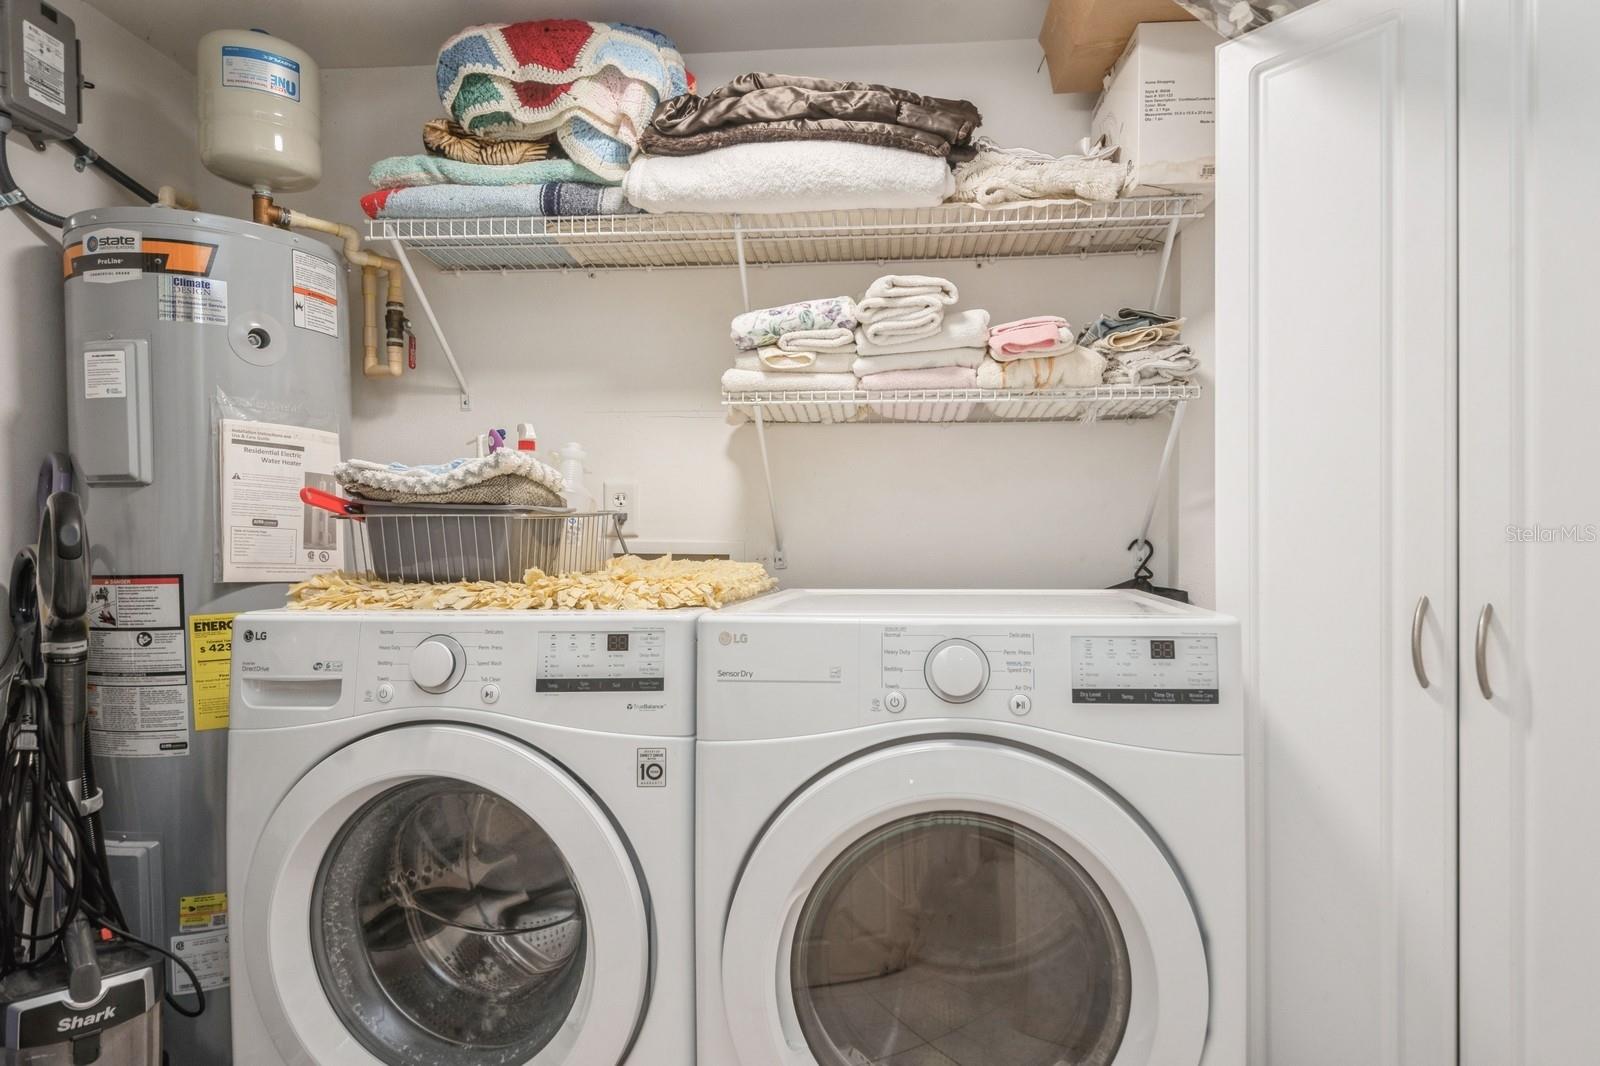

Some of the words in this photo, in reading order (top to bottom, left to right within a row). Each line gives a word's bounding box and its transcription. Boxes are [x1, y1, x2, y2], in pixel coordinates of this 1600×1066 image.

[99, 236, 135, 246] state
[173, 277, 211, 290] Climate
[173, 286, 211, 296] DESIGN
[243, 446, 280, 456] Residential
[280, 450, 302, 459] Electric
[261, 456, 280, 465] Water
[281, 459, 302, 467] Heater
[255, 631, 268, 641] LG
[733, 633, 748, 644] LG
[639, 763, 664, 781] 10
[56, 1006, 117, 1033] Shark
